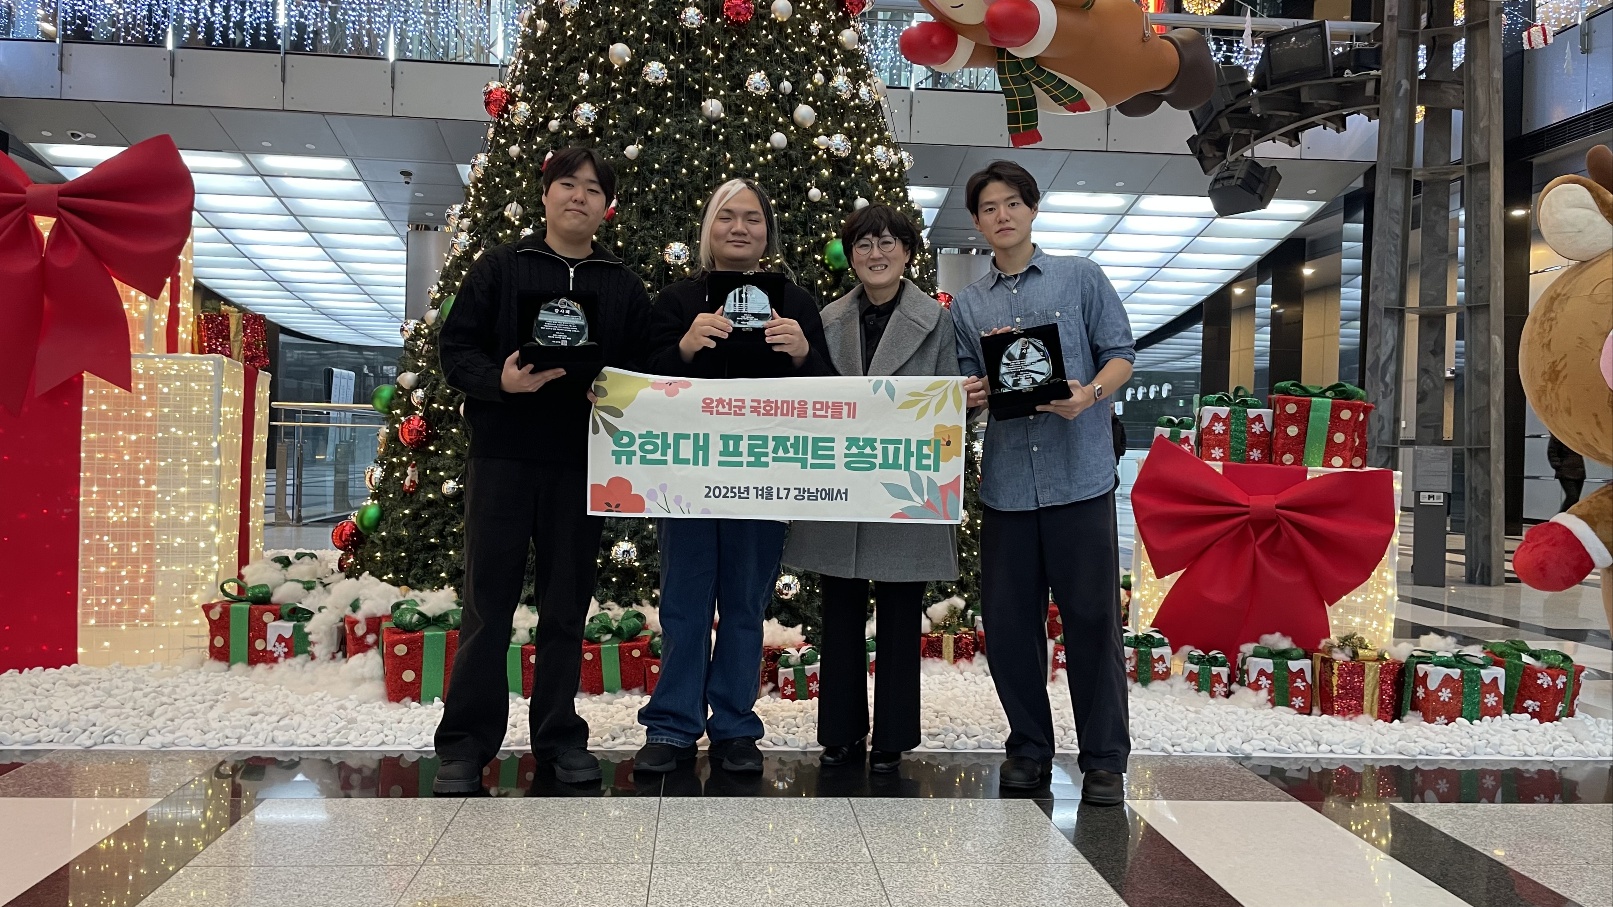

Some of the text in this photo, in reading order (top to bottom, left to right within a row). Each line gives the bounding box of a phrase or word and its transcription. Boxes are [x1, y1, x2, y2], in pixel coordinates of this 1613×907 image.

[701, 397, 857, 420] 옥천군 국화마을 만들기
[611, 430, 941, 473] 유한대 프로젝트 쫑파티
[703, 485, 848, 502] 2025년 겨울 L7 강남에서
